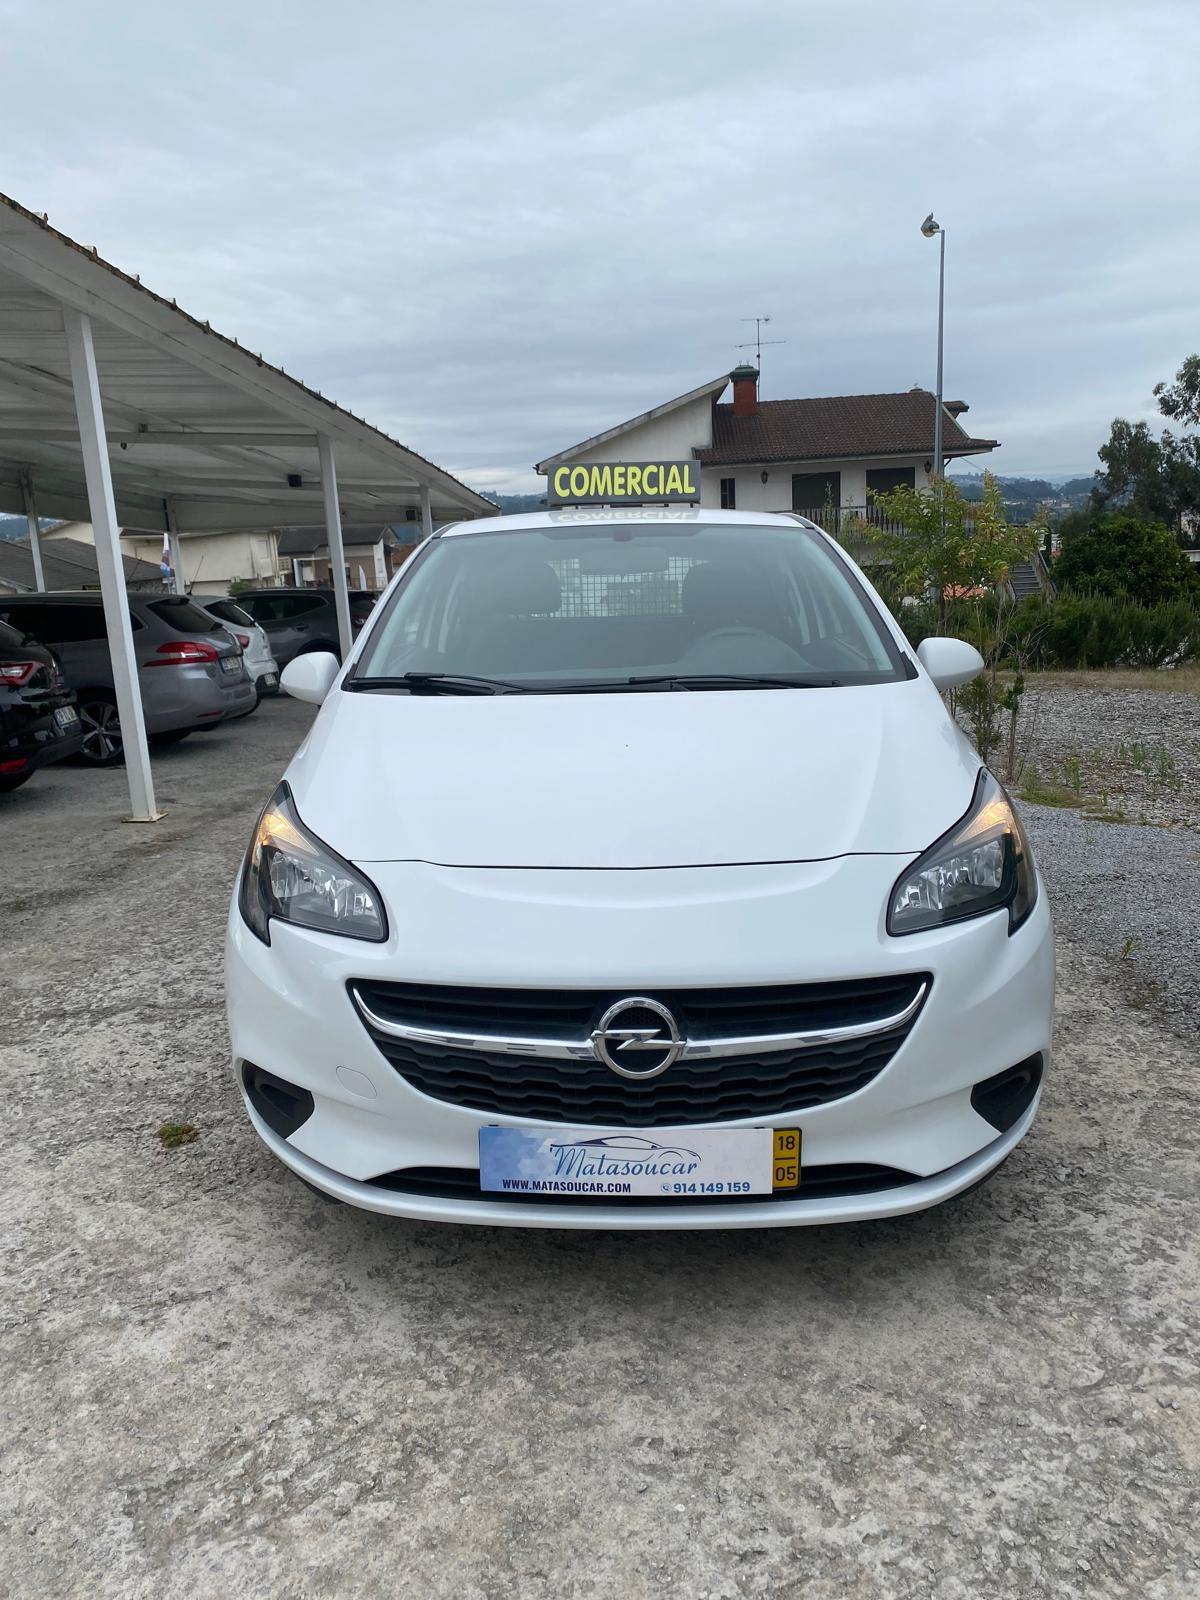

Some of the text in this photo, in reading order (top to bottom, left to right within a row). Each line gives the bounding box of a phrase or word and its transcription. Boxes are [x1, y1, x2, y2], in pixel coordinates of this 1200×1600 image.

[555, 464, 696, 497] COMERCIAL
[778, 1135, 796, 1151] 18
[554, 1147, 698, 1178] Matasoucar
[775, 1166, 797, 1181] 05
[502, 1178, 632, 1194] WWW.MATASOUCAR.COM
[673, 1182, 750, 1194] 914 149 159
